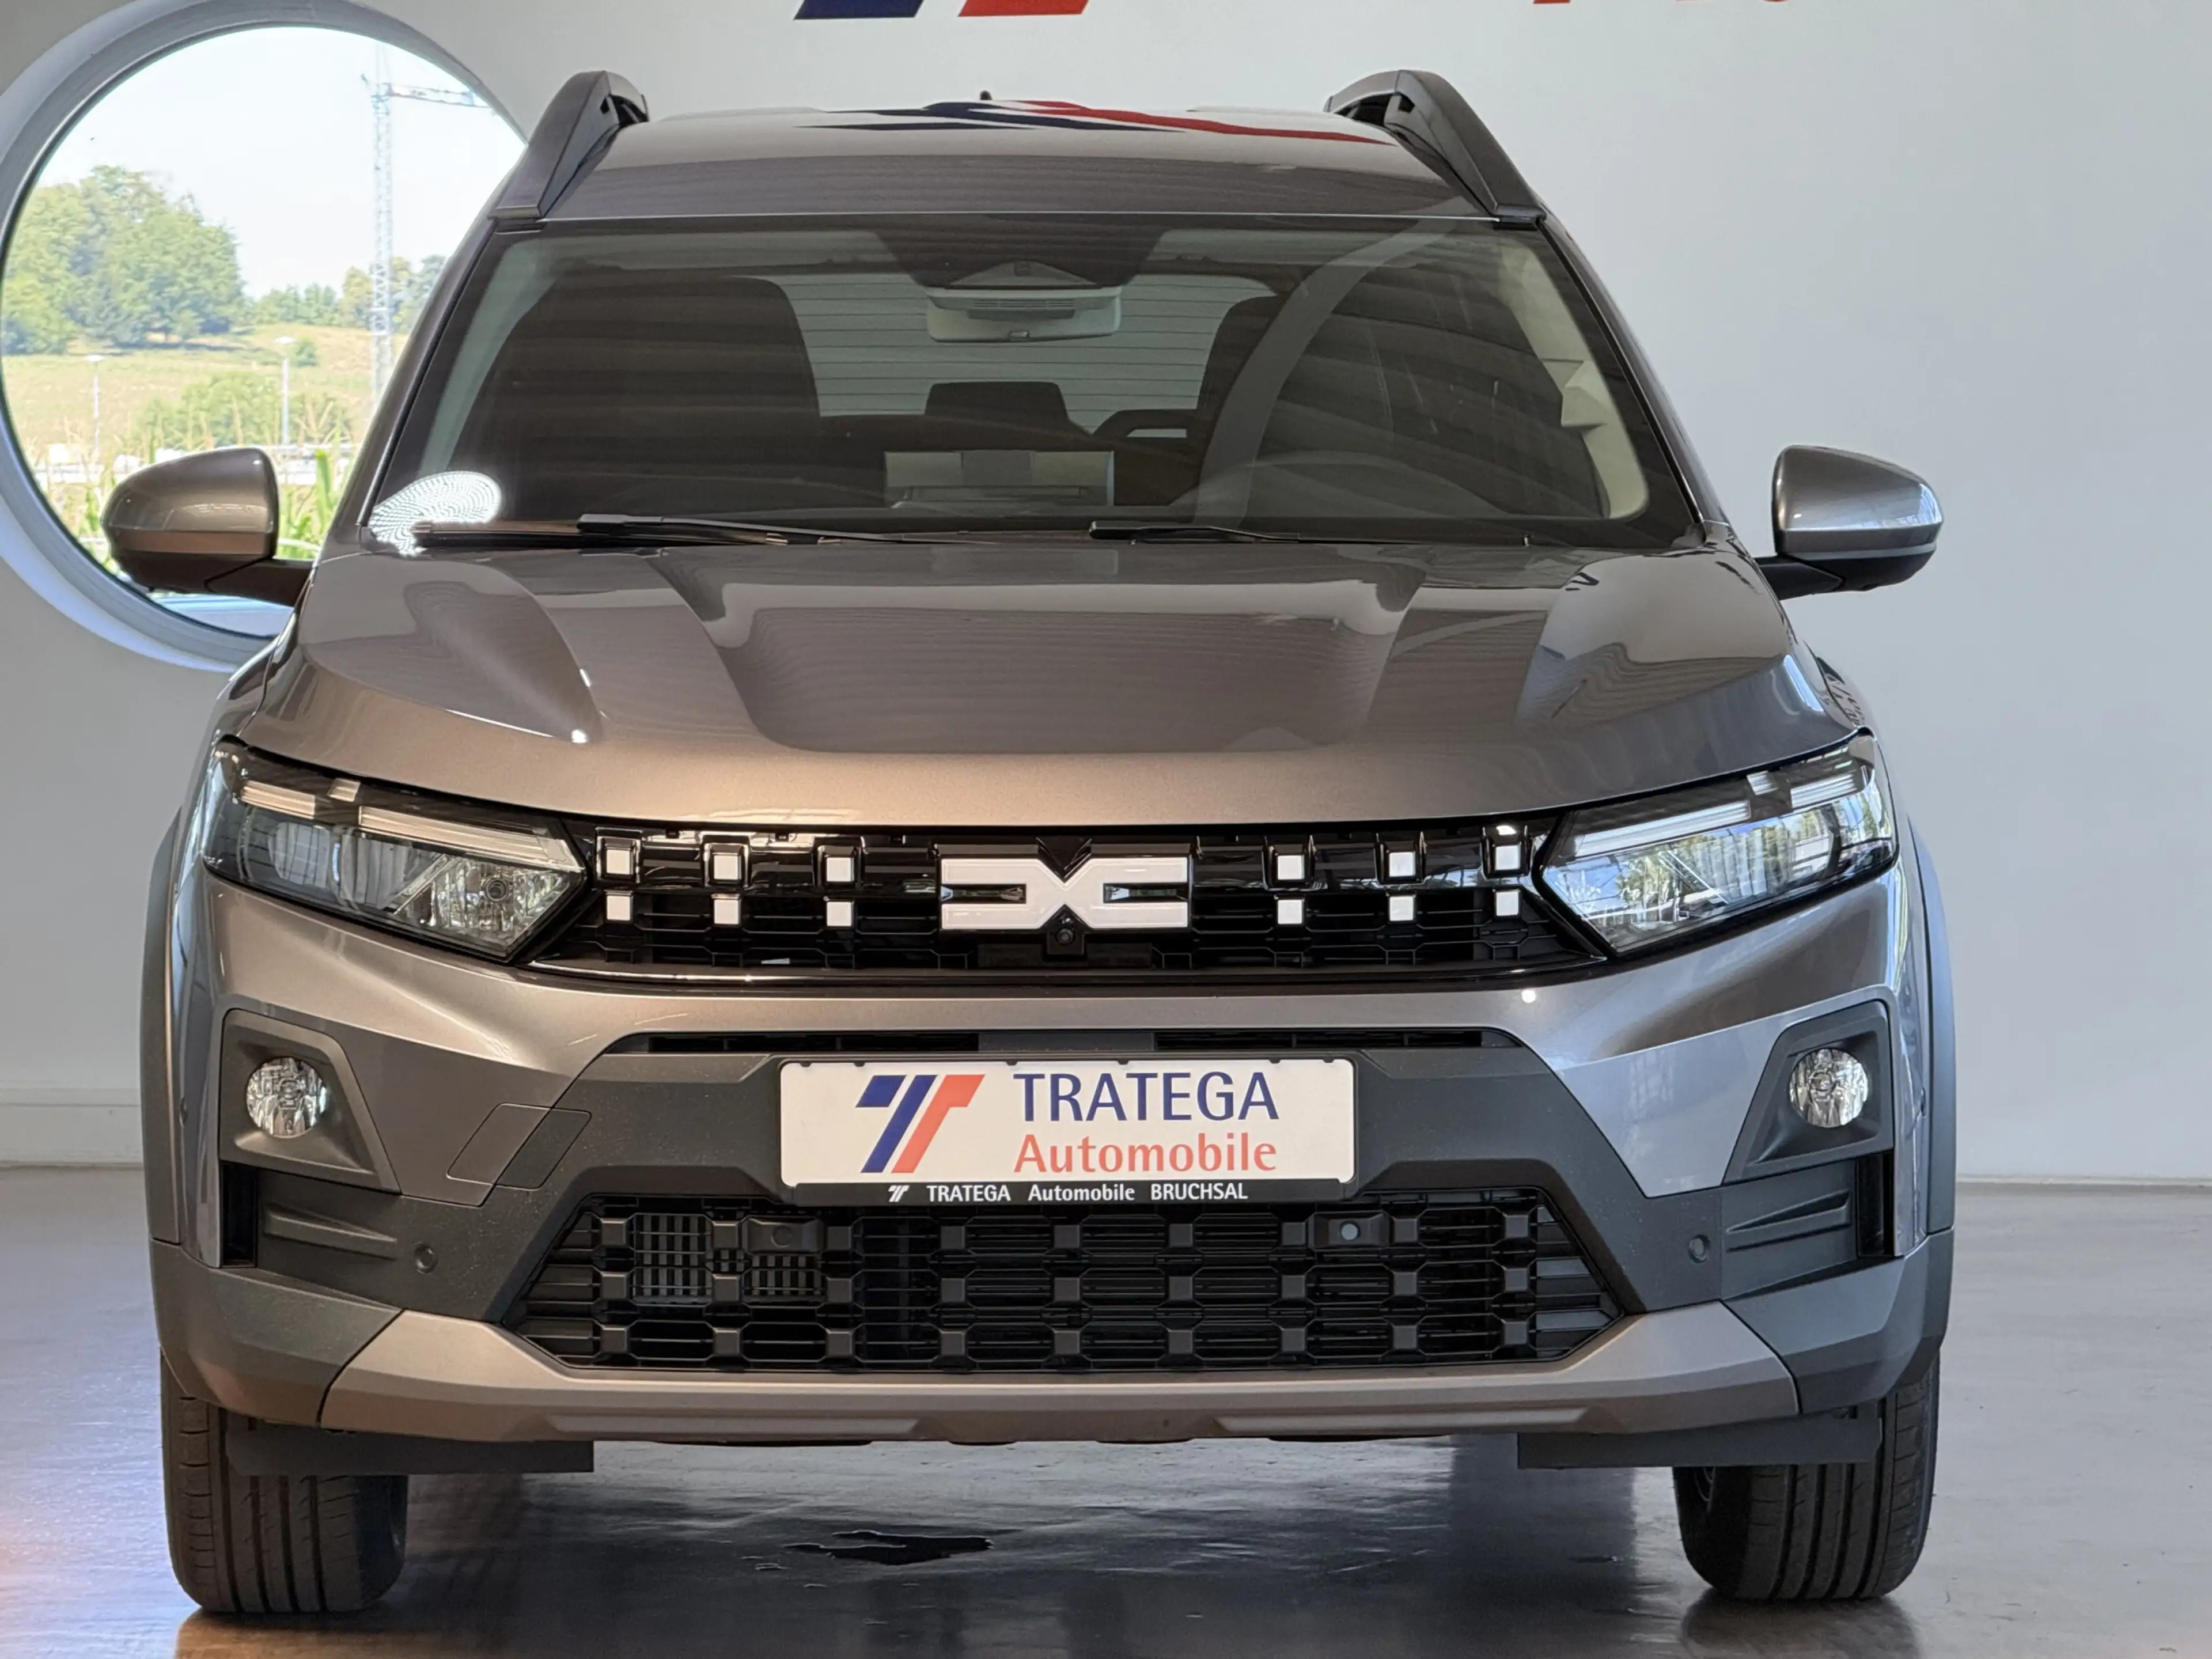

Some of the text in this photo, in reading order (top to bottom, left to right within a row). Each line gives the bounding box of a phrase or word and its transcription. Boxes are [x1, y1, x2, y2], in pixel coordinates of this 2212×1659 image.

[1013, 1071, 1279, 1122] TRATEGA
[1016, 1133, 1276, 1173] Automobile
[926, 1183, 1248, 1202] TRATEGA Automobile BRUCHSAL
